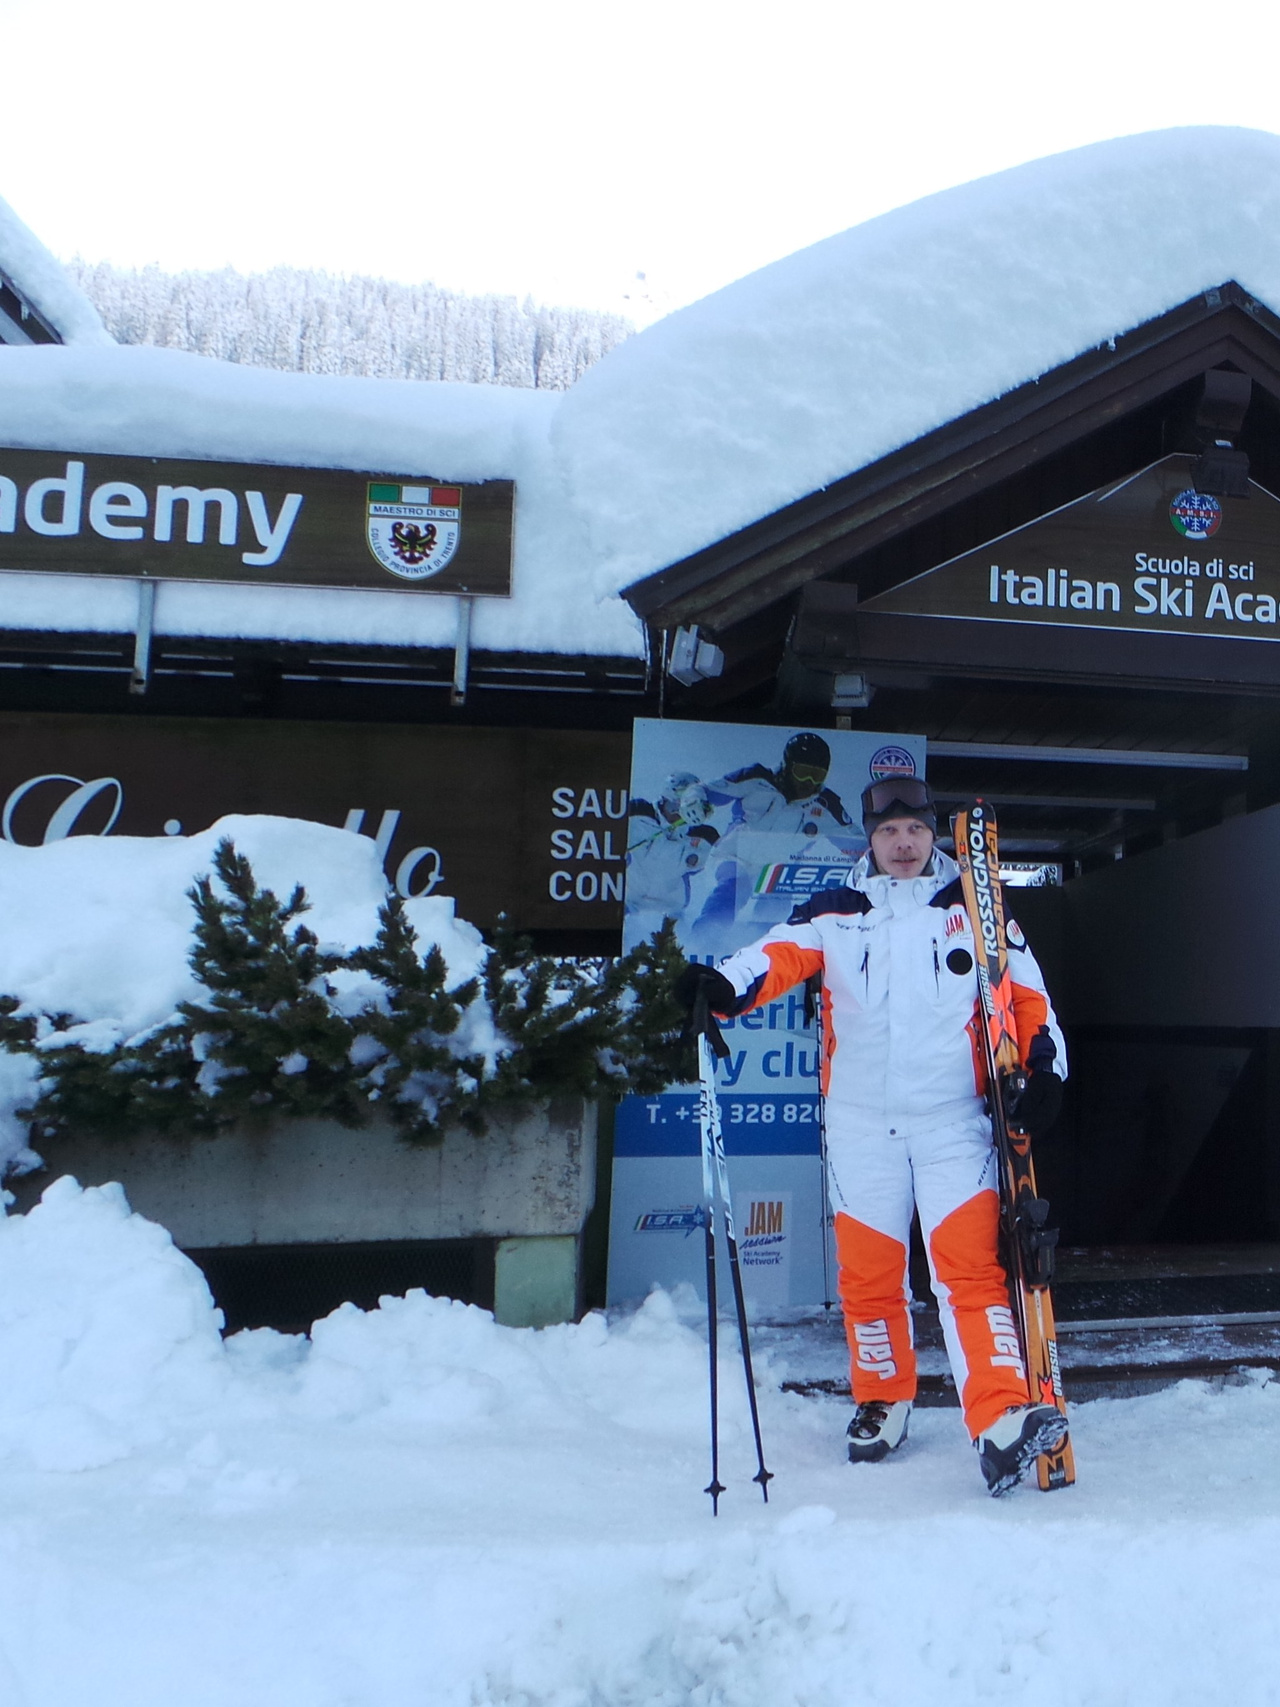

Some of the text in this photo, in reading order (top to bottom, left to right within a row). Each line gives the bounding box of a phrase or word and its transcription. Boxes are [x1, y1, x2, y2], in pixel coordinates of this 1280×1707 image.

[373, 505, 423, 515] MAESTRO
[371, 528, 455, 574] COLLEGIO PROVINCIA DI TRENTO
[1134, 552, 1254, 581] Scuola di sci
[989, 565, 1121, 612] Italian
[1133, 577, 1194, 617] Ski
[551, 787, 628, 819] SAU
[549, 870, 624, 901] CON
[970, 818, 999, 957] ROSSIGNOL
[945, 914, 965, 938] JAM
[978, 964, 996, 1016] OVERSIZE
[645, 1104, 666, 1124] T.
[730, 1104, 775, 1124] 328
[700, 1079, 708, 1118] LEKI
[744, 1201, 783, 1236] JAM
[743, 1257, 780, 1266] Network
[1048, 1339, 1062, 1397] OVERSIZE
